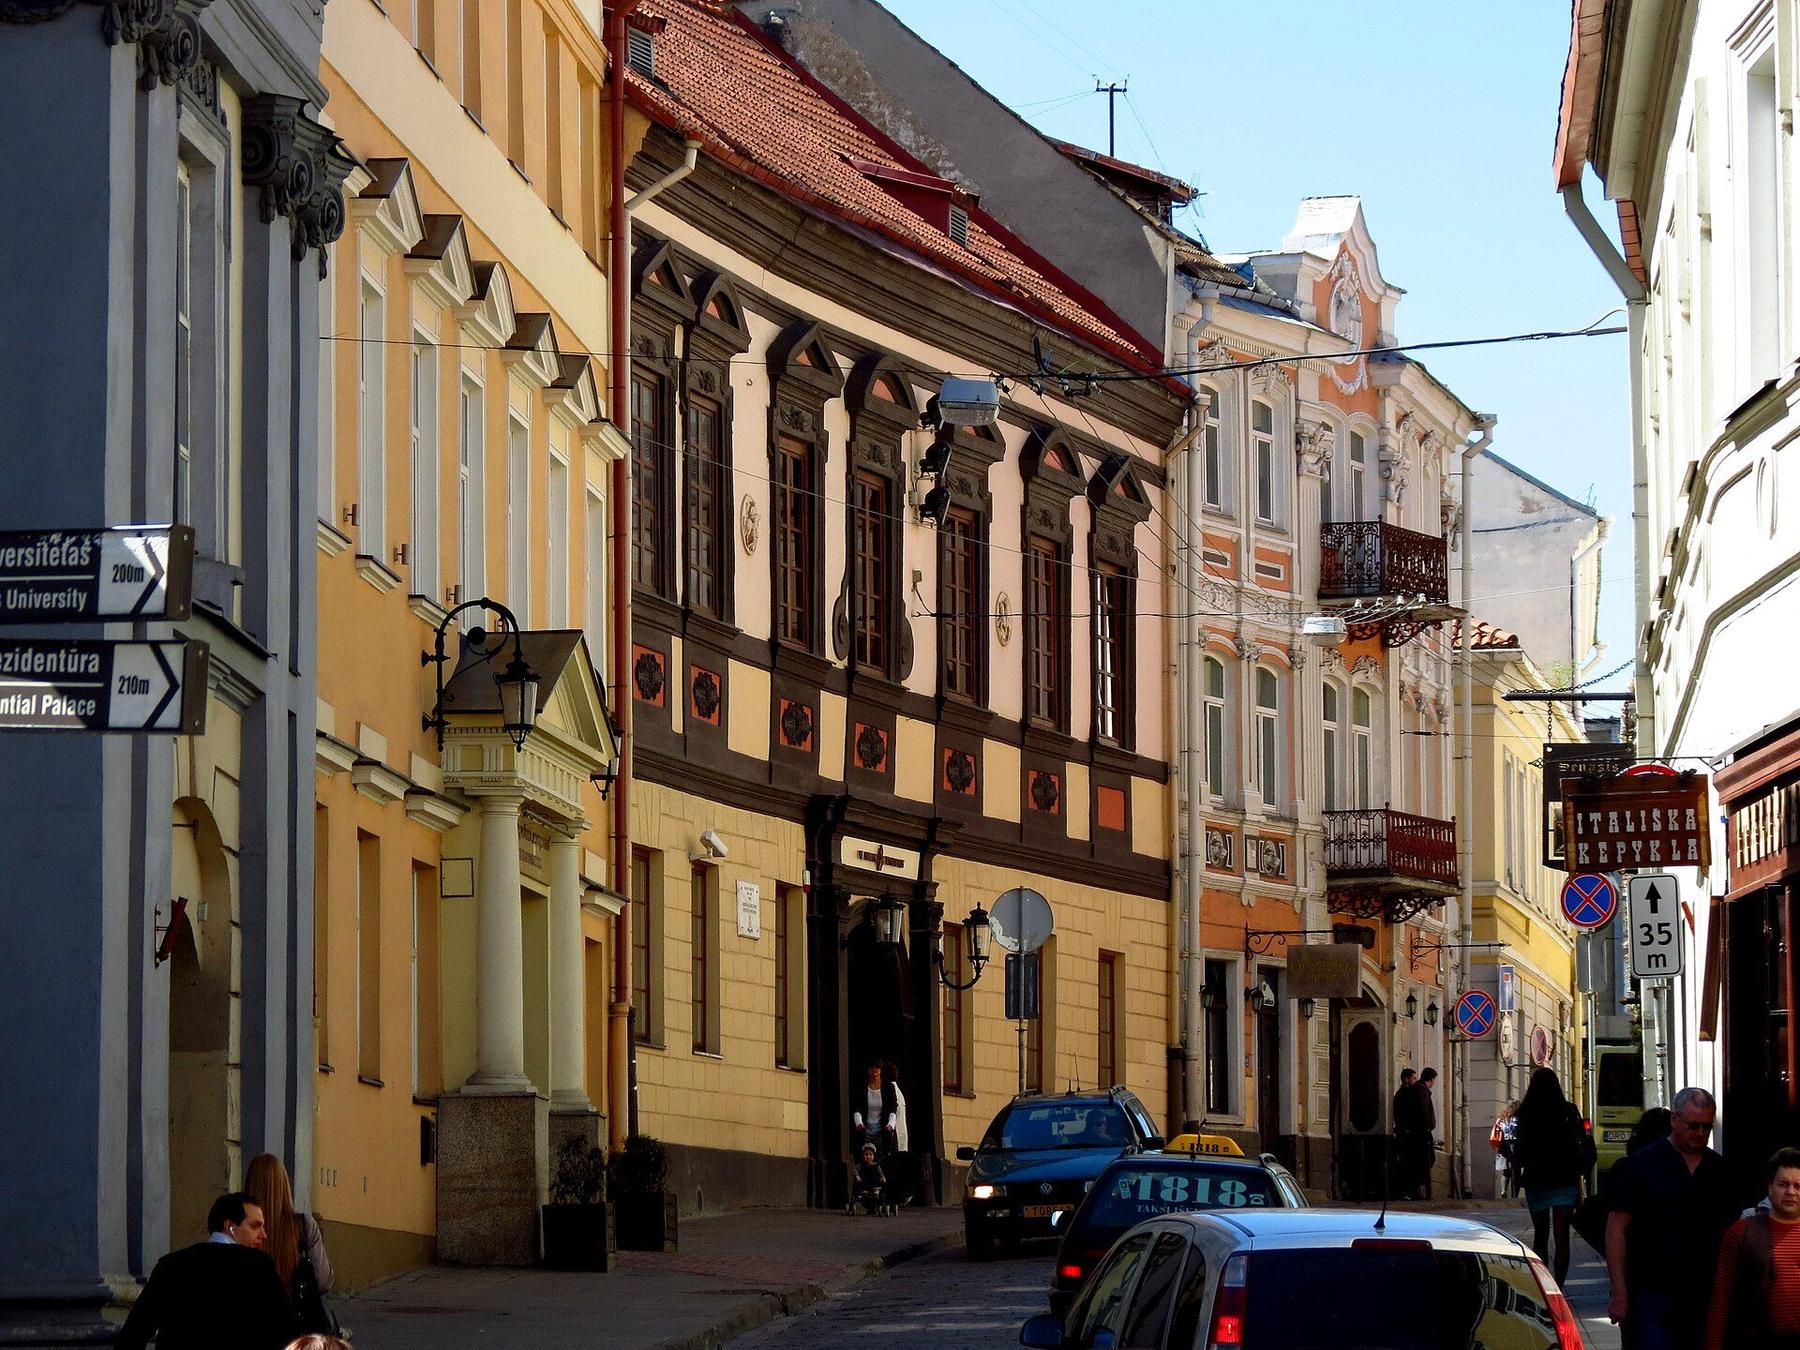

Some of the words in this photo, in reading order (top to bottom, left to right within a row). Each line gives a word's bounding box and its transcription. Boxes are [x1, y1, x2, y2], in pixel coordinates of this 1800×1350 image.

[112, 564, 144, 583] 200m
[6, 588, 88, 612] University
[118, 675, 150, 694] 210m
[41, 694, 96, 716] Palace
[1577, 808, 1696, 834] ITALIŠKA
[1578, 838, 1698, 864] KEPYKLA
[1640, 922, 1672, 946] 35
[1647, 951, 1667, 968] m
[1190, 1143, 1219, 1152] 1818
[1138, 1175, 1247, 1207] 1818
